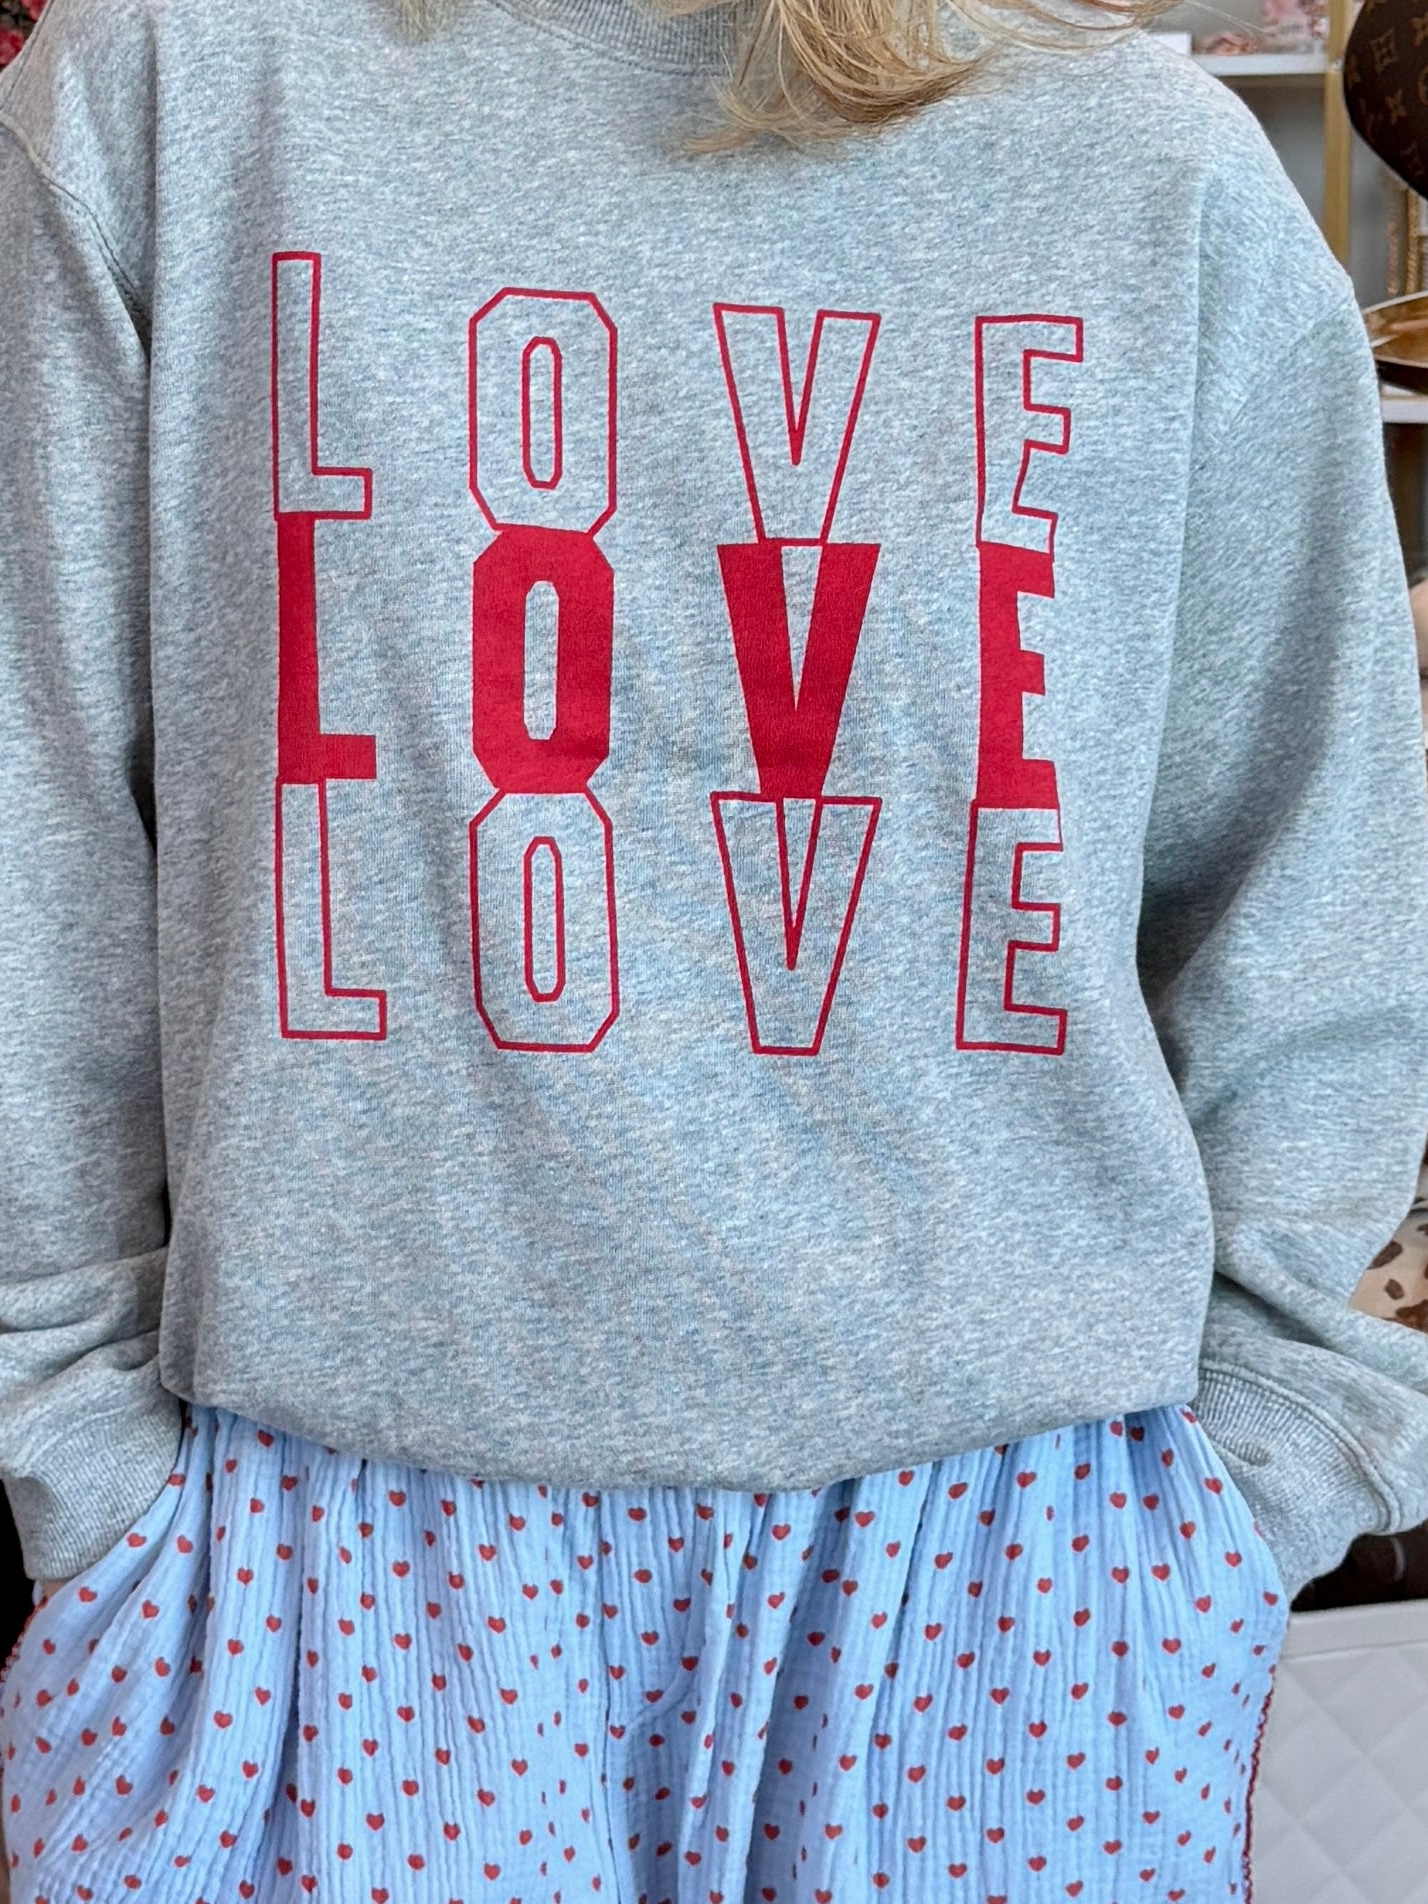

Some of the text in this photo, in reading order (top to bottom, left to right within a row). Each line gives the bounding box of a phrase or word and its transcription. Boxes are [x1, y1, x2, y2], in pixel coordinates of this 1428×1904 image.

[272, 252, 1084, 554] LOVE
[276, 511, 1057, 810] LOVE
[275, 777, 1068, 1056] LOVE
